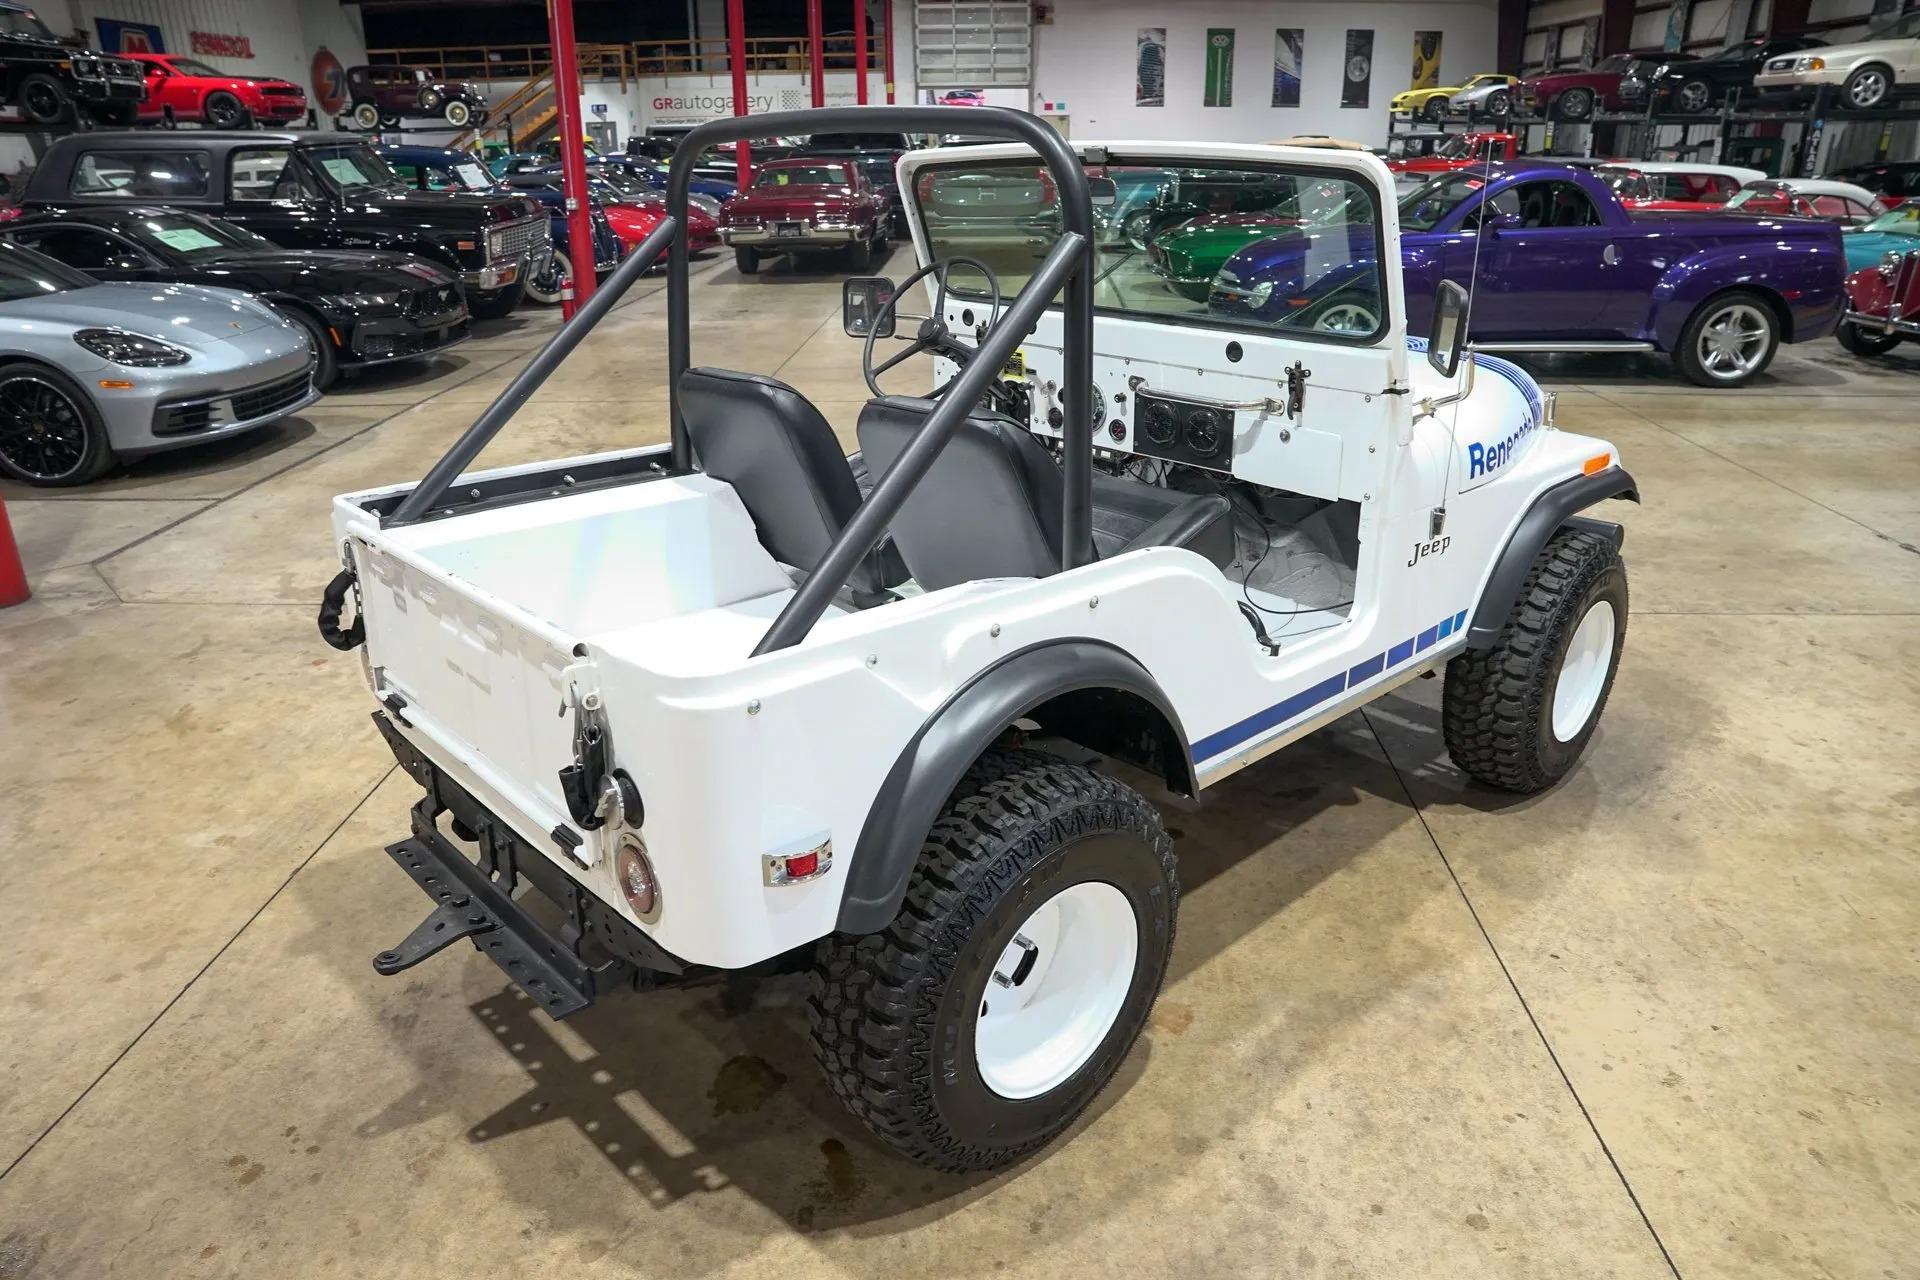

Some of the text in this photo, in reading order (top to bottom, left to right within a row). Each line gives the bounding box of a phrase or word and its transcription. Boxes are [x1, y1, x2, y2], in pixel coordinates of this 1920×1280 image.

[653, 95, 774, 114] GRautogaery
[1805, 129, 1822, 171] ATLAS
[1407, 536, 1451, 568] Jeep
